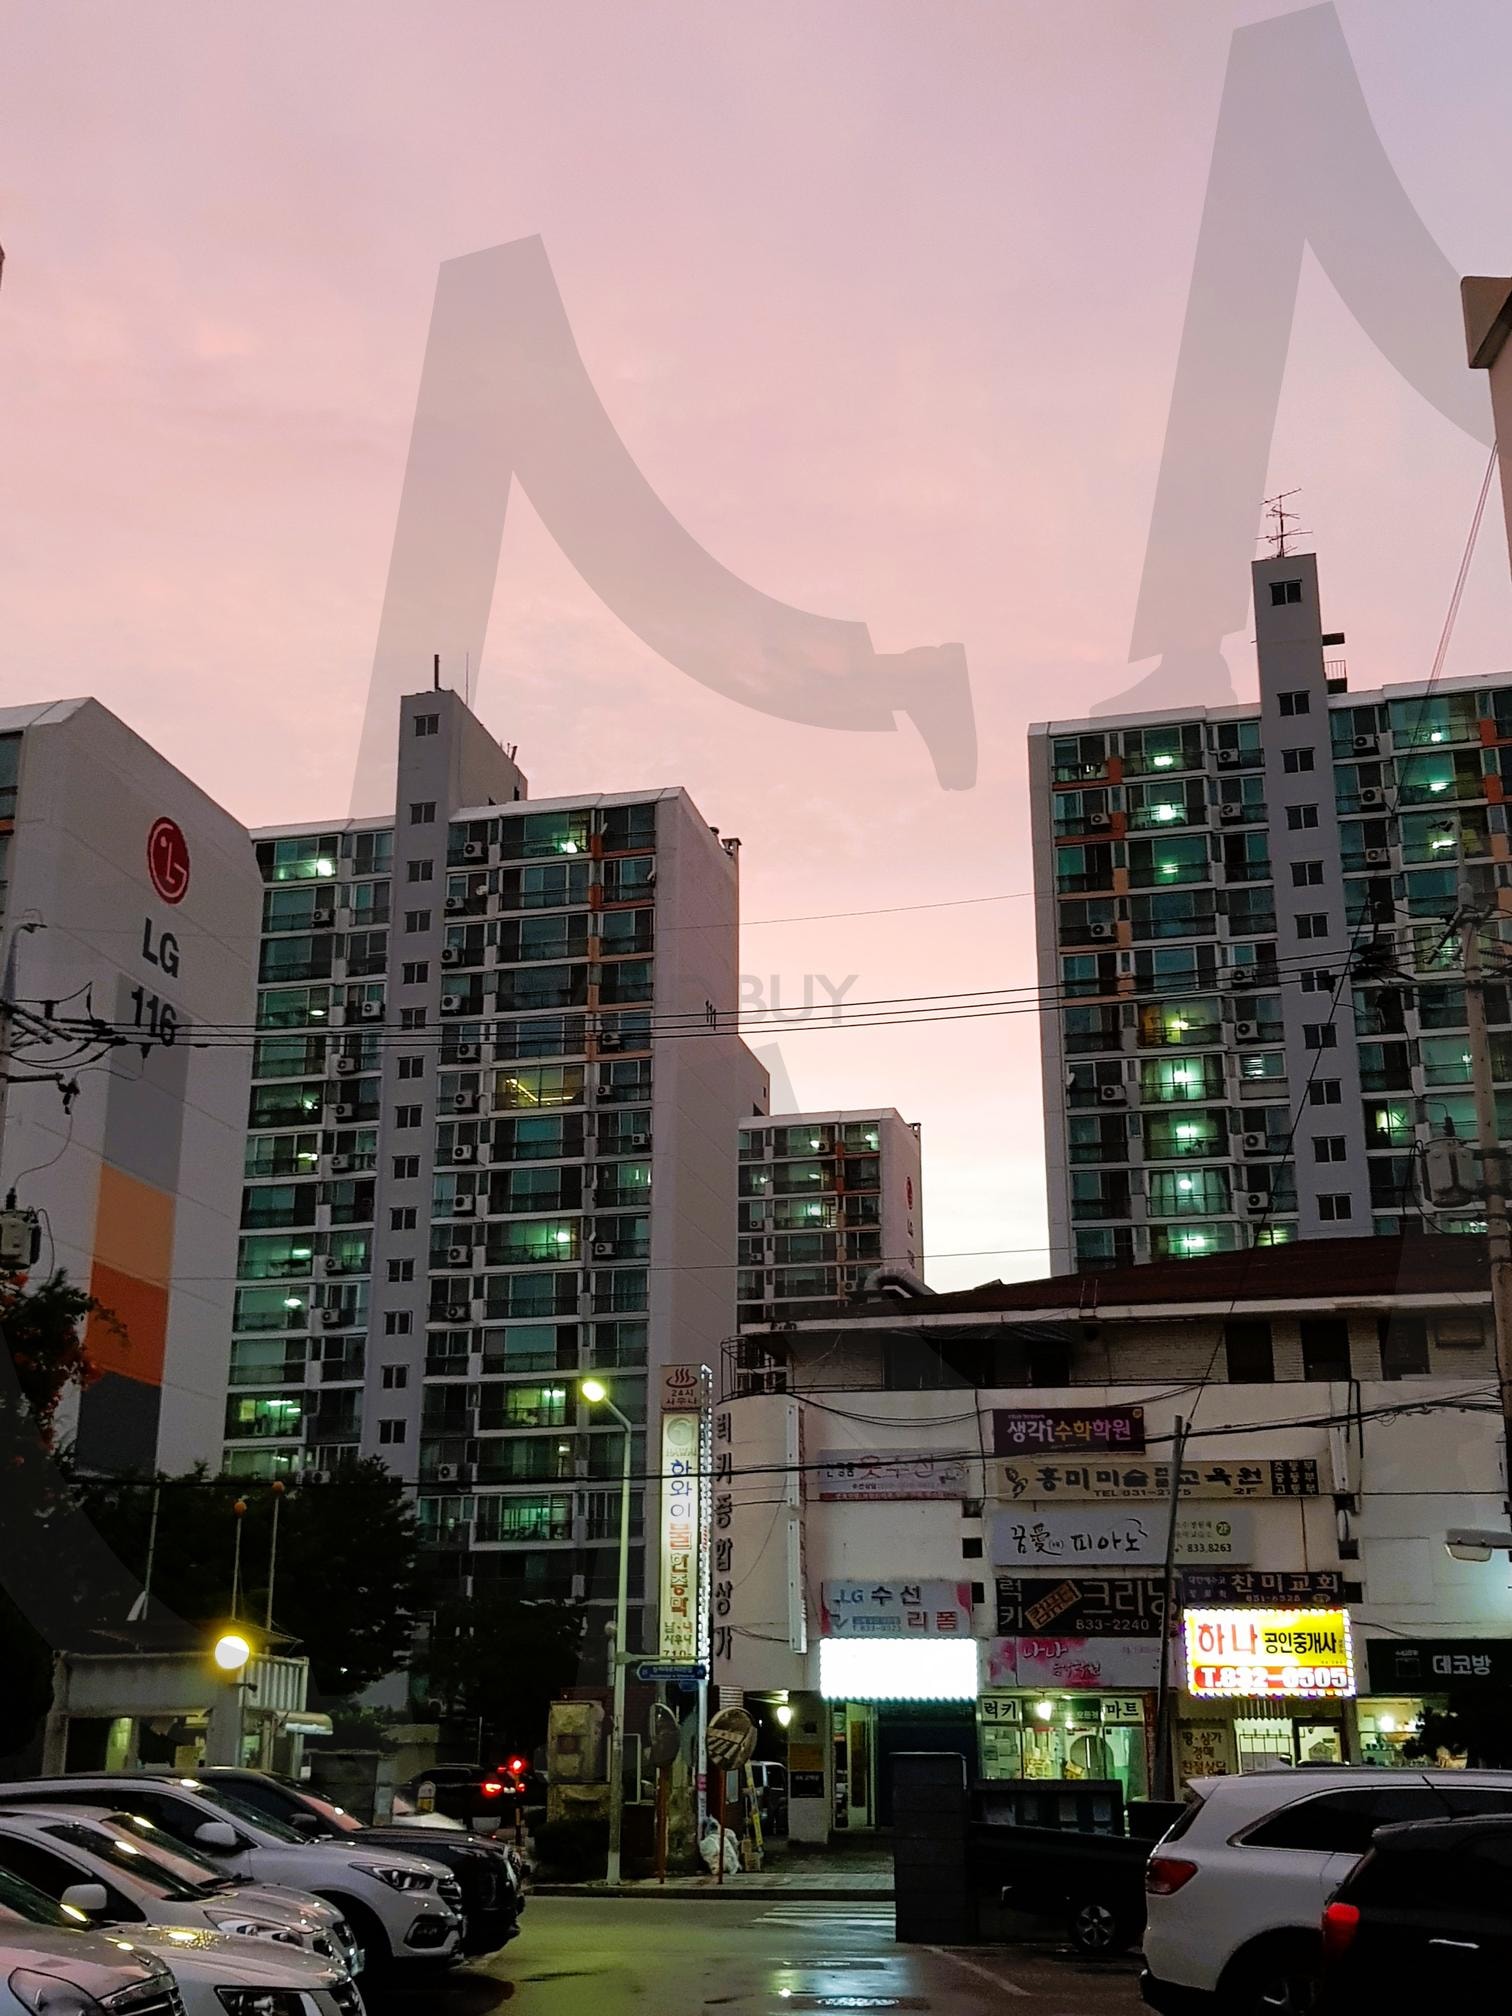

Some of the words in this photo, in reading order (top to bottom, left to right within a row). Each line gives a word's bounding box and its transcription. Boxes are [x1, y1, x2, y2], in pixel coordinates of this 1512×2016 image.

[141, 916, 180, 979] LG
[131, 986, 177, 1047] 116
[671, 1389, 694, 1397] 24시
[670, 1459, 693, 1518] 하와이
[1094, 1489, 1118, 1497] TEL
[1233, 1487, 1257, 1495] 2F
[1070, 1528, 1142, 1552] 피아노
[1231, 1573, 1338, 1593] 찬미교회
[840, 1588, 864, 1604] LG
[871, 1585, 922, 1606] 수선
[1075, 1618, 1149, 1631] 833-2240
[1198, 1623, 1259, 1655] 하나
[1264, 1631, 1337, 1655] 공인중개사
[1024, 1641, 1068, 1659] 나나
[1432, 1654, 1493, 1676] 데코방
[983, 1699, 1017, 1719] 럭키
[1106, 1699, 1140, 1719] 마트
